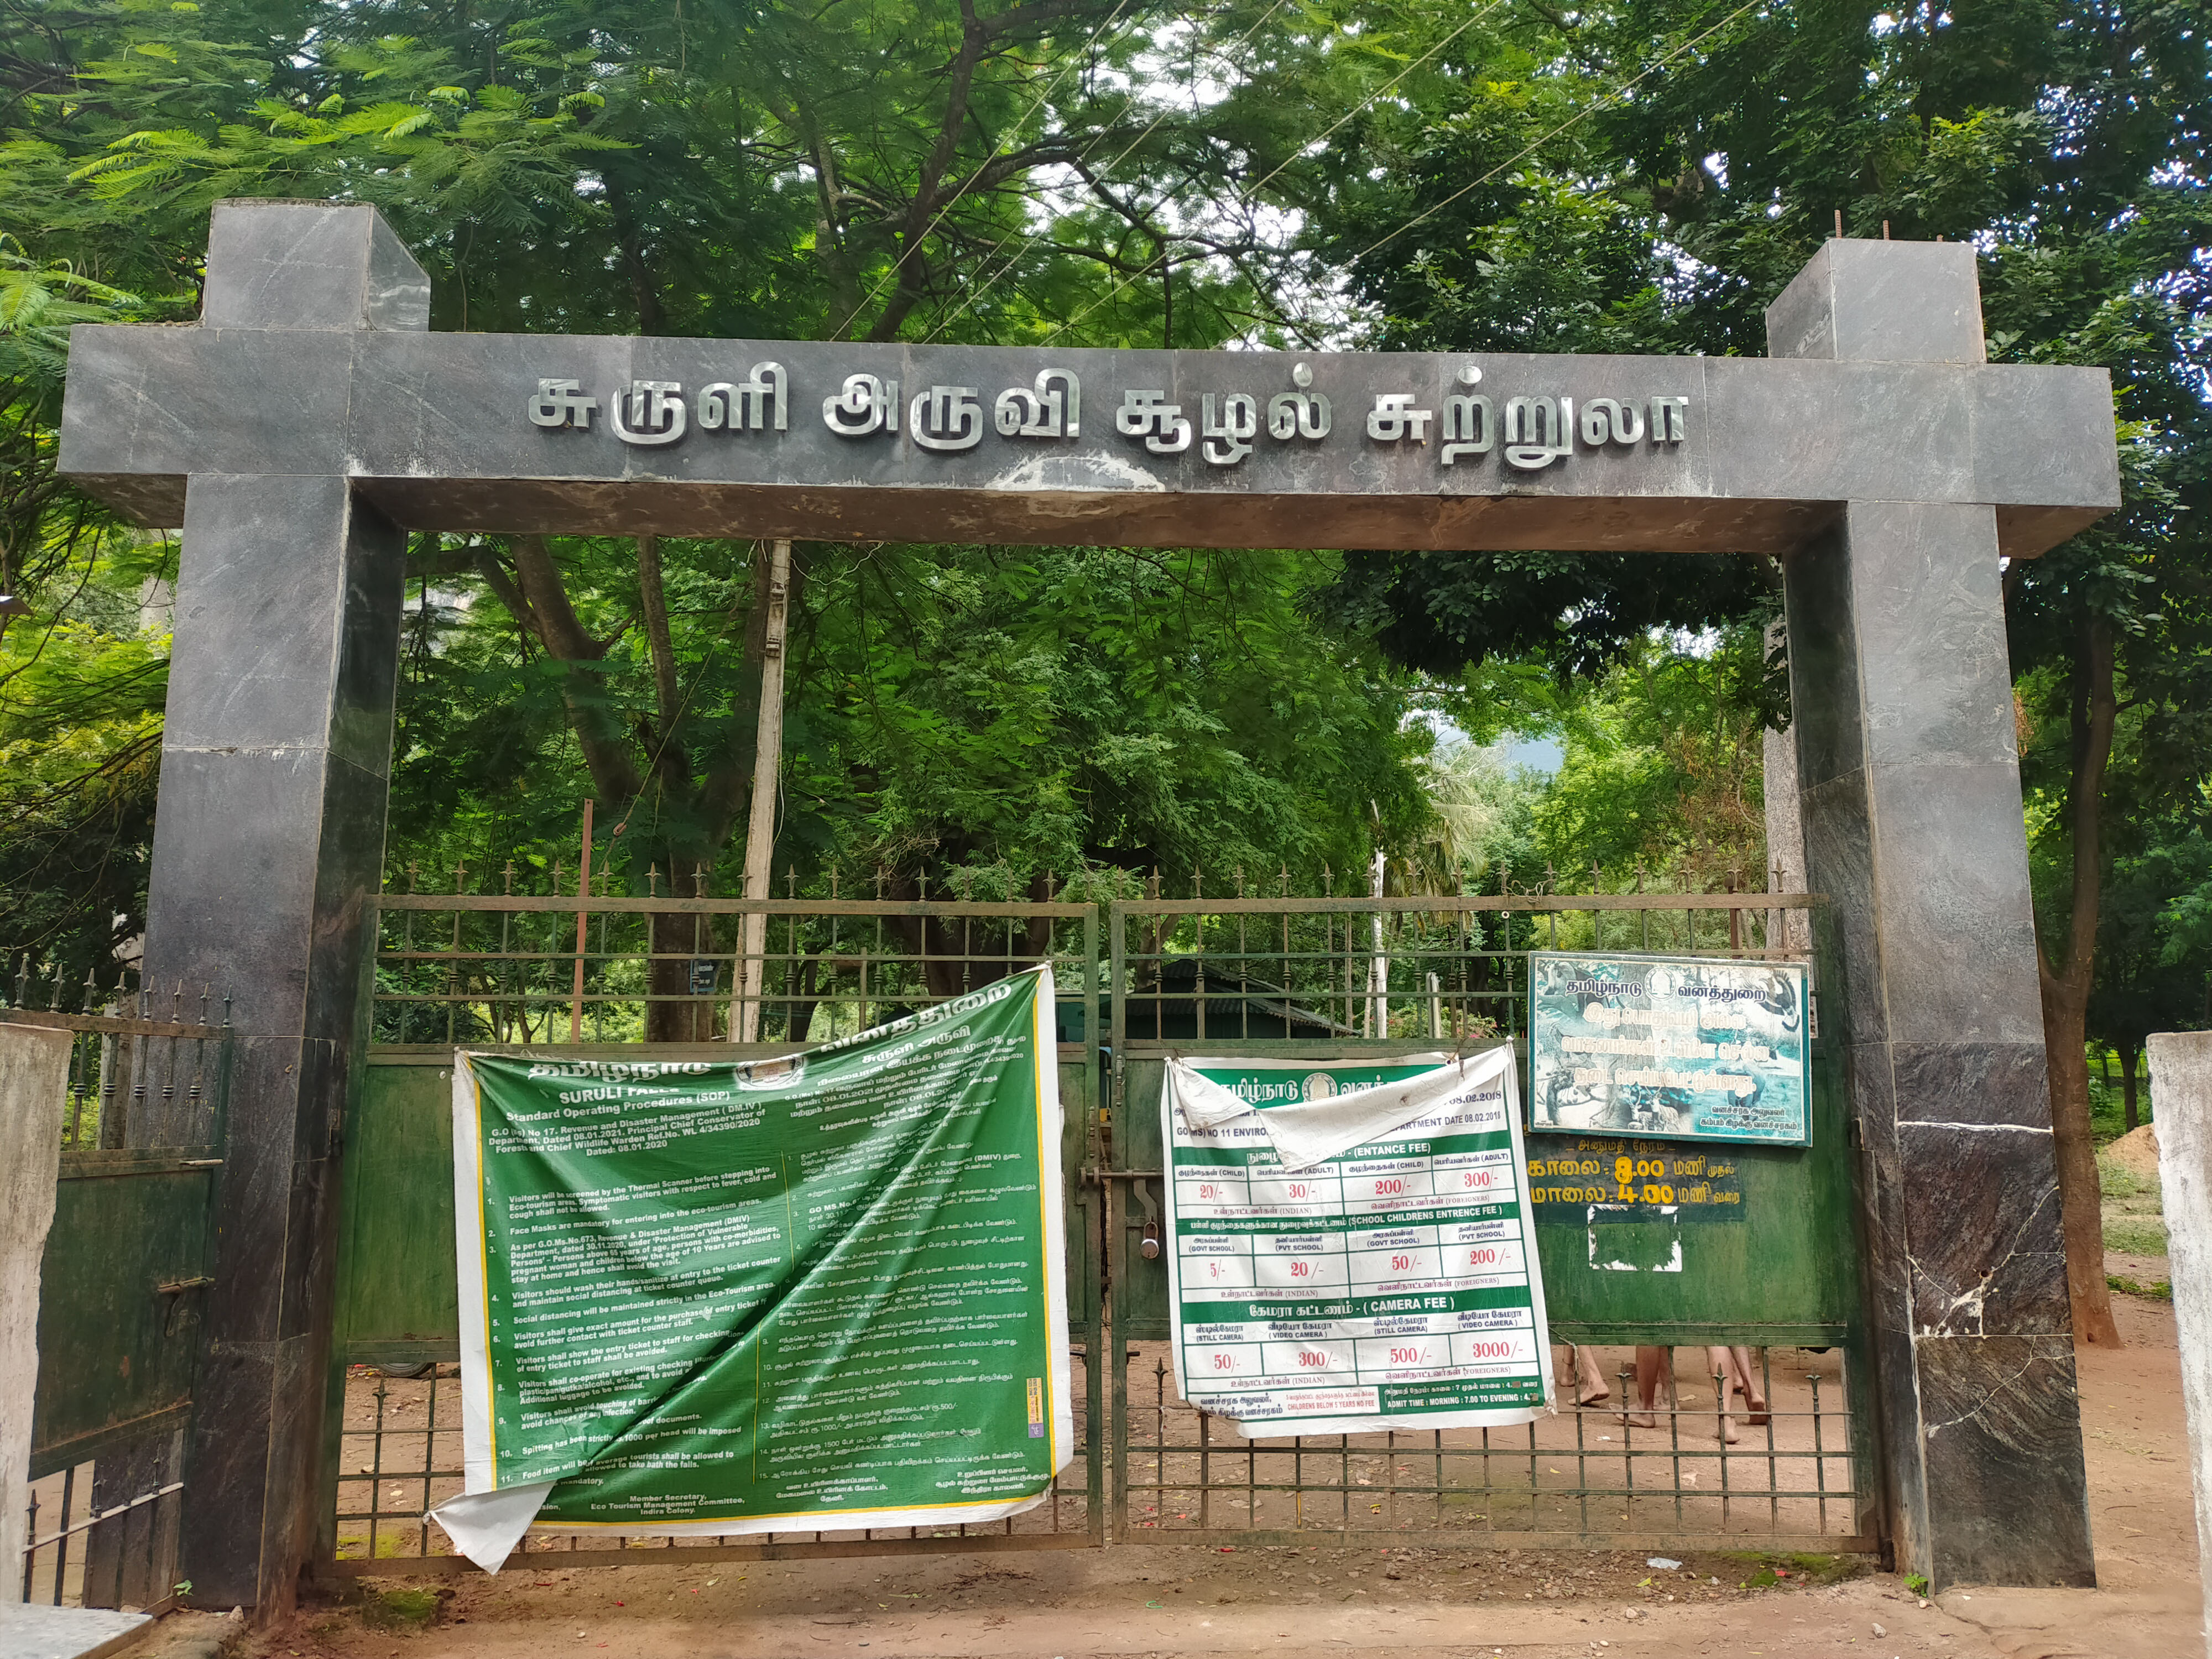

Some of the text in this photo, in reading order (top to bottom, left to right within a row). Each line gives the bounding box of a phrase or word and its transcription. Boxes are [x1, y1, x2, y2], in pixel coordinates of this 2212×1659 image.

[527, 361, 1688, 471] சுருளி அருவி சூழல் சுற்றுலா
[1566, 979, 1766, 1003] தமிழ்நாடு வனத்துறை
[862, 1042, 914, 1064] சுருளி
[559, 1087, 622, 1104] SURULI
[507, 1091, 730, 1121] Standard Operating Procedures (SOP)
[561, 1125, 598, 1134] Revenue
[620, 1118, 657, 1128] Disaster
[660, 1108, 719, 1122] Management
[1445, 1111, 1500, 1125] DATE 08.02.2018
[489, 1137, 540, 1146] Department,
[543, 1136, 571, 1144] Dated
[573, 1130, 625, 1140] 08.01.2021.
[627, 1124, 667, 1135] Principal
[670, 1119, 695, 1130] Chief
[697, 1112, 753, 1125] Conservator
[575, 1140, 608, 1149] Wildlife
[611, 1135, 645, 1145] Warden
[682, 1128, 697, 1136] WL
[700, 1118, 760, 1133] 4/34390/2020
[1221, 1128, 1230, 1137] 11
[618, 1139, 667, 1152] 08.01.2020
[1354, 1142, 1431, 1158] (ENTANCE FEE)
[1397, 1161, 1424, 1170] (CHILD)
[1481, 1153, 1508, 1162] (ADULT)
[1527, 1160, 1600, 1177] காலை
[1674, 1156, 1705, 1176] மணி
[1305, 1167, 1333, 1175] (ADULT)
[1464, 1167, 1498, 1188] 300/-
[1200, 1181, 1223, 1202] 20/-
[1290, 1181, 1315, 1201] 30/-
[1375, 1176, 1411, 1196] 200/-
[1531, 1187, 1605, 1203] மாலை
[1678, 1181, 1711, 1203] மணி
[1446, 1196, 1490, 1205] (FOREIGNERS)
[531, 1224, 556, 1233] Masks
[573, 1220, 609, 1229] mandatory
[625, 1214, 657, 1225] entering
[691, 1203, 736, 1214] eco-tourism
[1349, 1215, 1385, 1227] (SCHOOL
[1387, 1211, 1434, 1222] CHILDRENS
[1437, 1208, 1480, 1218] ENTRENCE
[1483, 1206, 1496, 1214] FEE
[1459, 1230, 1505, 1241] (PVT SCHOOL)
[1211, 1259, 1225, 1281] 5/-
[1454, 1277, 1499, 1288] (FOREIGNERS)
[1285, 1290, 1318, 1298] (INDIAN)
[1249, 1297, 1447, 1317] கேமரா கட்டணம் CAMERA FEE
[1391, 1347, 1431, 1364] 500/-
[1473, 1341, 1523, 1358] 3000/-
[1214, 1354, 1240, 1373] 50/-
[1299, 1352, 1338, 1369] 300/-
[1292, 1377, 1324, 1385] (INDIAN)
[1387, 1399, 1406, 1408] ADMIT
[1430, 1397, 1459, 1406] MORNING
[644, 1500, 696, 1509] Management
